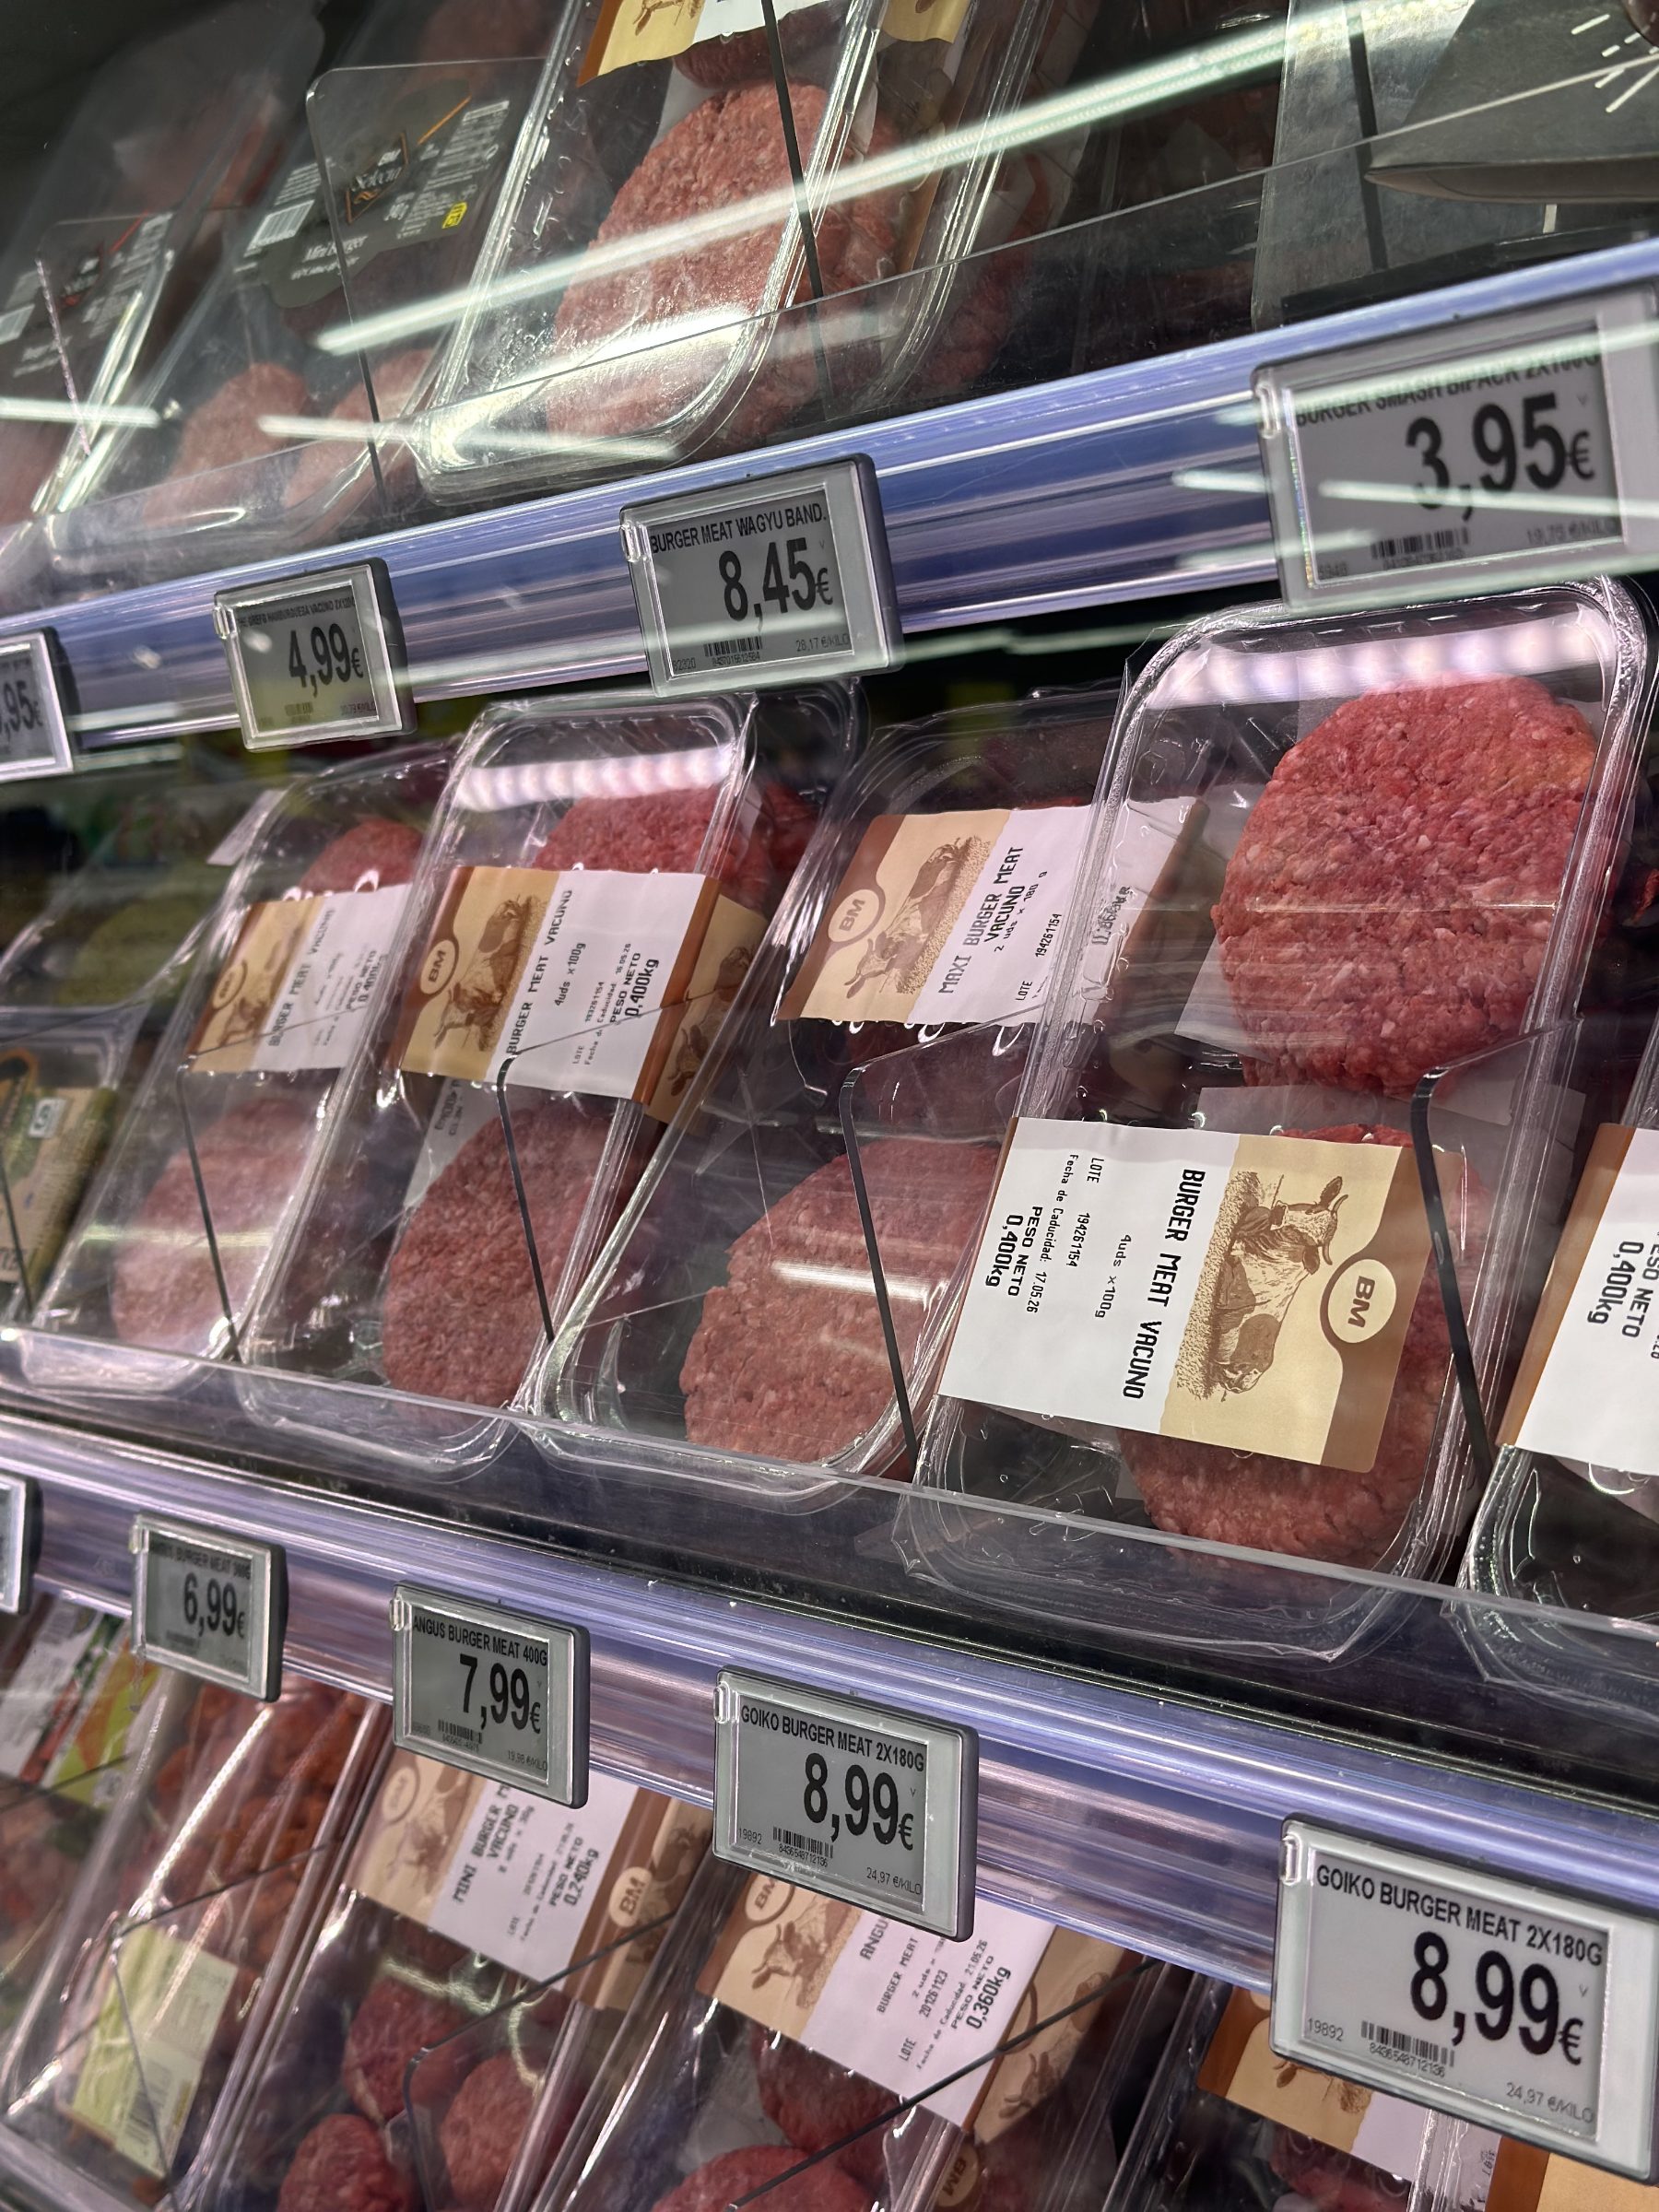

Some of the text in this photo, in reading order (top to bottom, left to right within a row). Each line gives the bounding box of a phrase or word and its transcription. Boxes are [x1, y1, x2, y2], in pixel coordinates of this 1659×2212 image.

[1406, 392, 1595, 522] 3,95€
[650, 502, 828, 553] BURGER MEAT WAGYU BAND.
[719, 536, 833, 631] 8,45€
[288, 623, 364, 698] 4,99€
[0, 679, 43, 743] ,95€
[840, 898, 866, 932] BM
[938, 847, 1023, 994] MAXI BURGER MEAT
[983, 886, 1025, 943] VACUNO
[428, 949, 446, 982] BM
[507, 889, 573, 1056] BURGER MEAT VACUNO
[609, 952, 641, 1023] PESO NETO
[625, 959, 660, 1018] 0,400kg
[1016, 981, 1032, 1001] LOTE
[1035, 913, 1062, 957] 194261154
[1026, 1154, 1078, 1313] Fecha de Caducidad: 17.05.26
[1065, 1157, 1105, 1267] LOTE 194261154
[985, 1214, 1024, 1288] 0,400kg
[1007, 1206, 1043, 1296] PESO NETO
[1112, 1233, 1132, 1267] 4uds
[1123, 1169, 1206, 1400] BURGER MEAT VACUNO
[1587, 1241, 1644, 1324] 0,400kg
[1347, 1275, 1376, 1328] BM
[1621, 1288, 1654, 1338] NETO
[183, 1572, 244, 1640] 6,99€
[413, 1616, 547, 1666] ANGUS BURGER MEAT 400G
[460, 1653, 541, 1735] 7,99€
[740, 1705, 924, 1771] GOIKO BURGER MEAT 2X180G
[804, 1752, 914, 1851] 8,99€
[866, 1866, 890, 1885] 24,97
[860, 1917, 889, 1960] ANGU
[1315, 1865, 1603, 1966] GOIKO BURGER MEAT 2X180G
[877, 1937, 919, 2013] BURGER MEAT
[966, 1967, 1011, 2030] 0,360kg
[1410, 1931, 1583, 2065] 8,99€
[950, 1994, 973, 2029] PESO
[1307, 2017, 1344, 2041] 19892
[1506, 2082, 1545, 2107] 24,97
